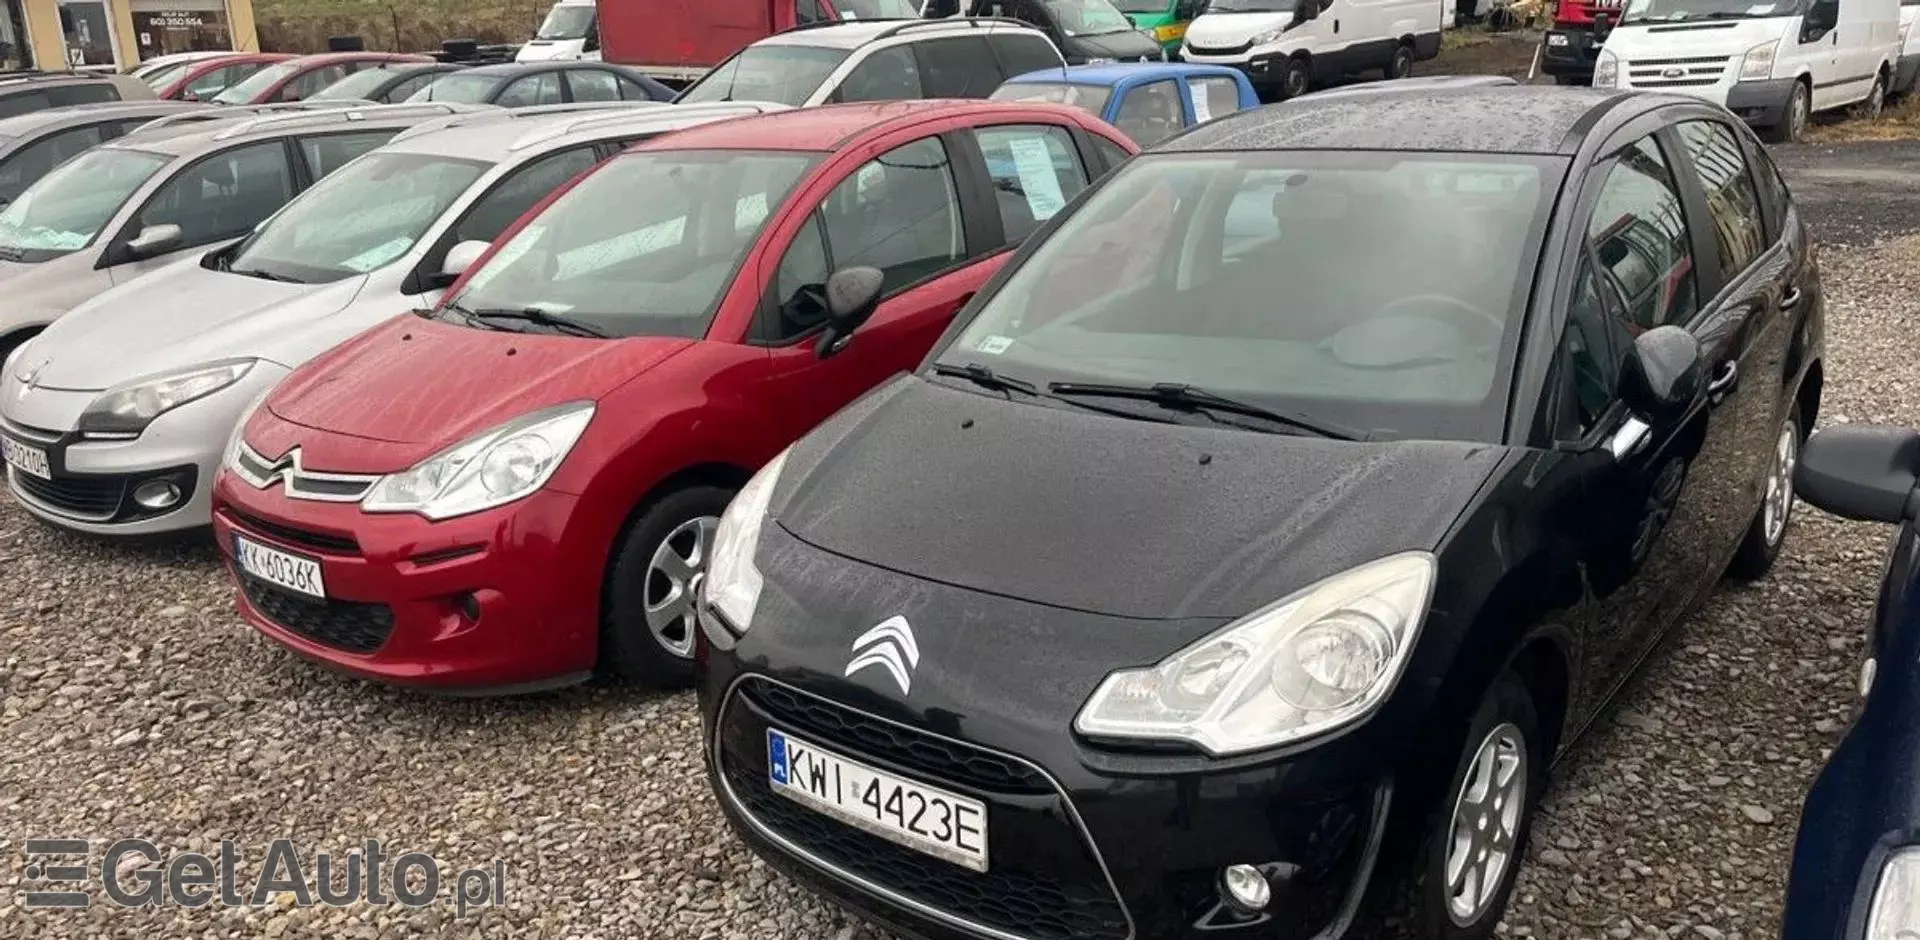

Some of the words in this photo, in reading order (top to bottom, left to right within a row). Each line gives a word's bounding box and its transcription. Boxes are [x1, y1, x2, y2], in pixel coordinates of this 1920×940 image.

[267, 552, 319, 594] 6036K
[787, 743, 842, 804] KWI
[862, 777, 981, 854] 4423E
